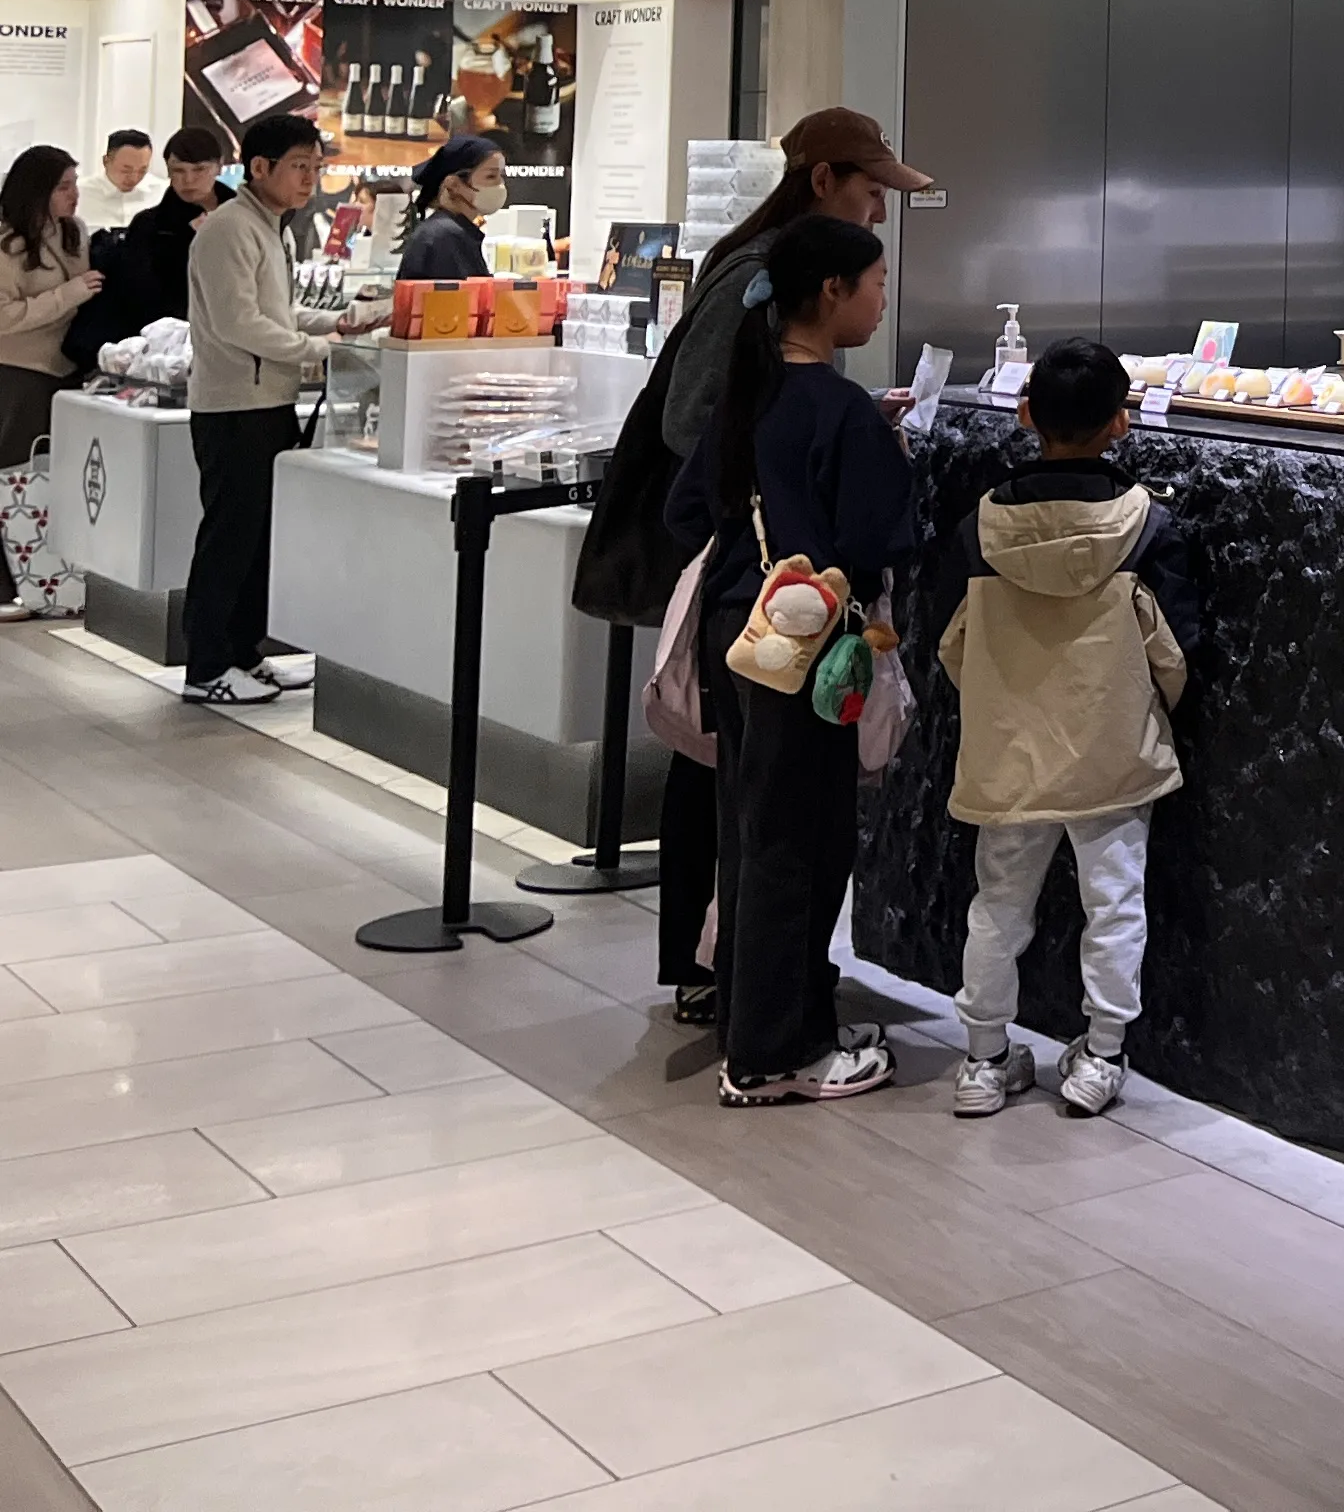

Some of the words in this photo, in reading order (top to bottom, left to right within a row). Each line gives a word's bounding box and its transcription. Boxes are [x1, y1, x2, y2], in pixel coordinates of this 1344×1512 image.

[463, 0, 506, 11] CRAFT
[510, 1, 568, 13] WONDER
[595, 8, 621, 26] CRAFT
[624, 6, 662, 24] WONDER
[0, 24, 67, 39] ONDER
[327, 165, 373, 177] CRAFT
[376, 165, 412, 177] WON
[505, 166, 564, 177] WONDER
